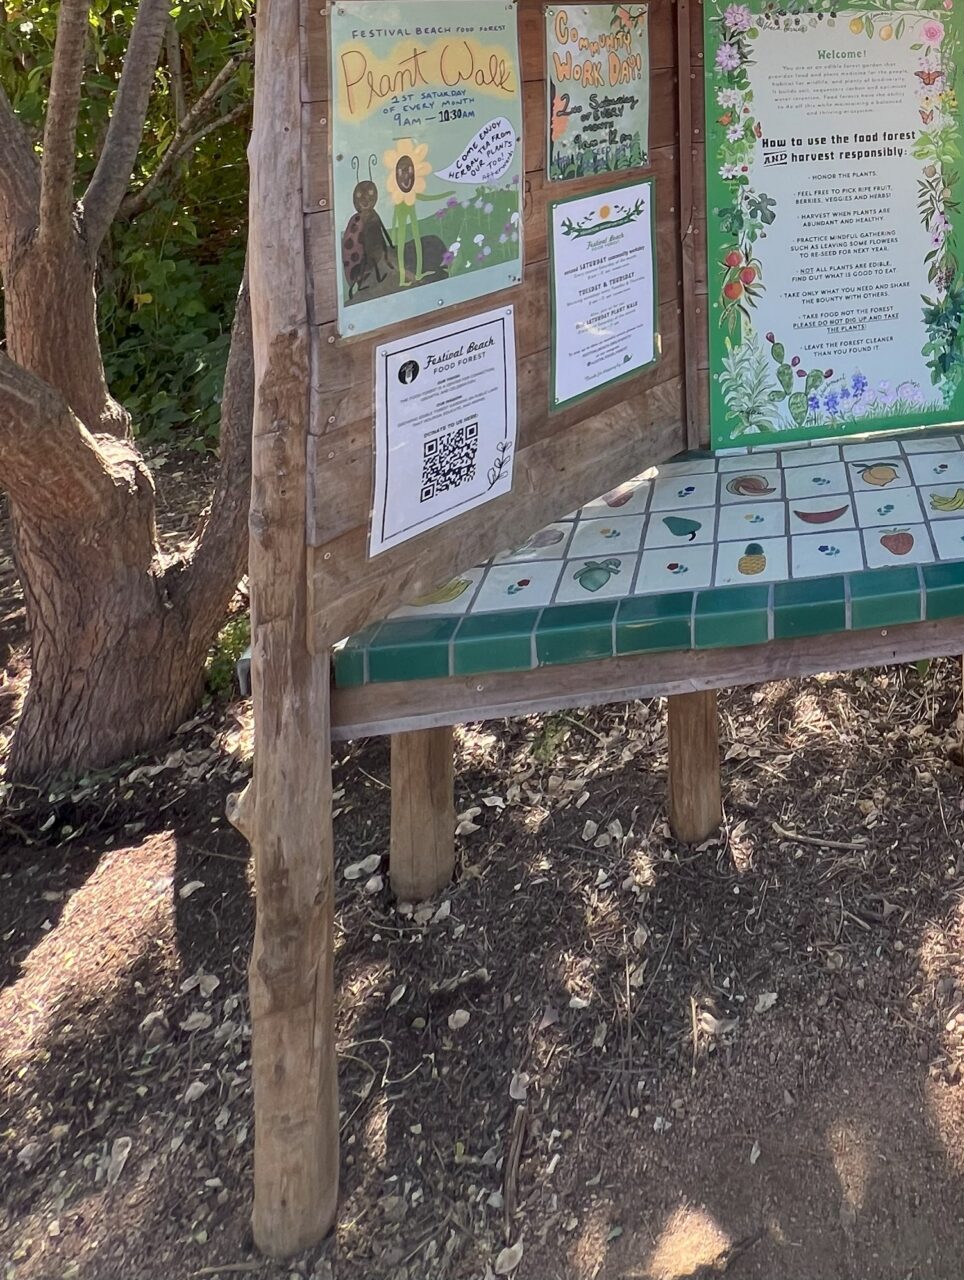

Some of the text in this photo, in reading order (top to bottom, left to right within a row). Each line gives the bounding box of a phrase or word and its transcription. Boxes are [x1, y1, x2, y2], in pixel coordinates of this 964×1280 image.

[352, 28, 412, 39] FESTIVAL
[416, 26, 451, 35] BEACH
[818, 50, 867, 60] Welcome!
[553, 51, 642, 88] WORK DAY!
[340, 41, 514, 114] Plant Walk
[391, 90, 466, 104] 1ST SATURDAY
[382, 98, 474, 114] OF EVERY MONTH
[393, 113, 421, 126] 9AM
[456, 142, 478, 169] COME
[479, 120, 501, 140] ENJOY
[762, 131, 916, 148] How to use the food forest
[449, 158, 479, 179] HERBAL
[478, 141, 490, 154] TEA
[491, 130, 511, 142] FROM
[471, 160, 485, 176] OUR
[487, 140, 512, 157] PLANTS
[487, 152, 504, 169] TOO!
[764, 147, 908, 164] AND harvest responsibly:
[825, 195, 852, 203] VEGGIES
[801, 212, 829, 220] HARVEST
[803, 219, 838, 227] ABUNDANT
[797, 235, 827, 243] PRACTICE
[830, 233, 857, 241] MINDFUL
[820, 242, 847, 250] LEAVING
[870, 238, 898, 246] FLOWERS
[811, 250, 837, 258] RE-SEED
[829, 264, 853, 272] PLANTS
[825, 272, 843, 280] WHAT
[816, 296, 842, 304] BOUNTY
[804, 343, 823, 351] LEAVE
[866, 336, 893, 344] CLEANER
[849, 346, 871, 354] FOUND
[423, 336, 495, 370] Festival Beach
[434, 352, 486, 374] FOOD FOREST
